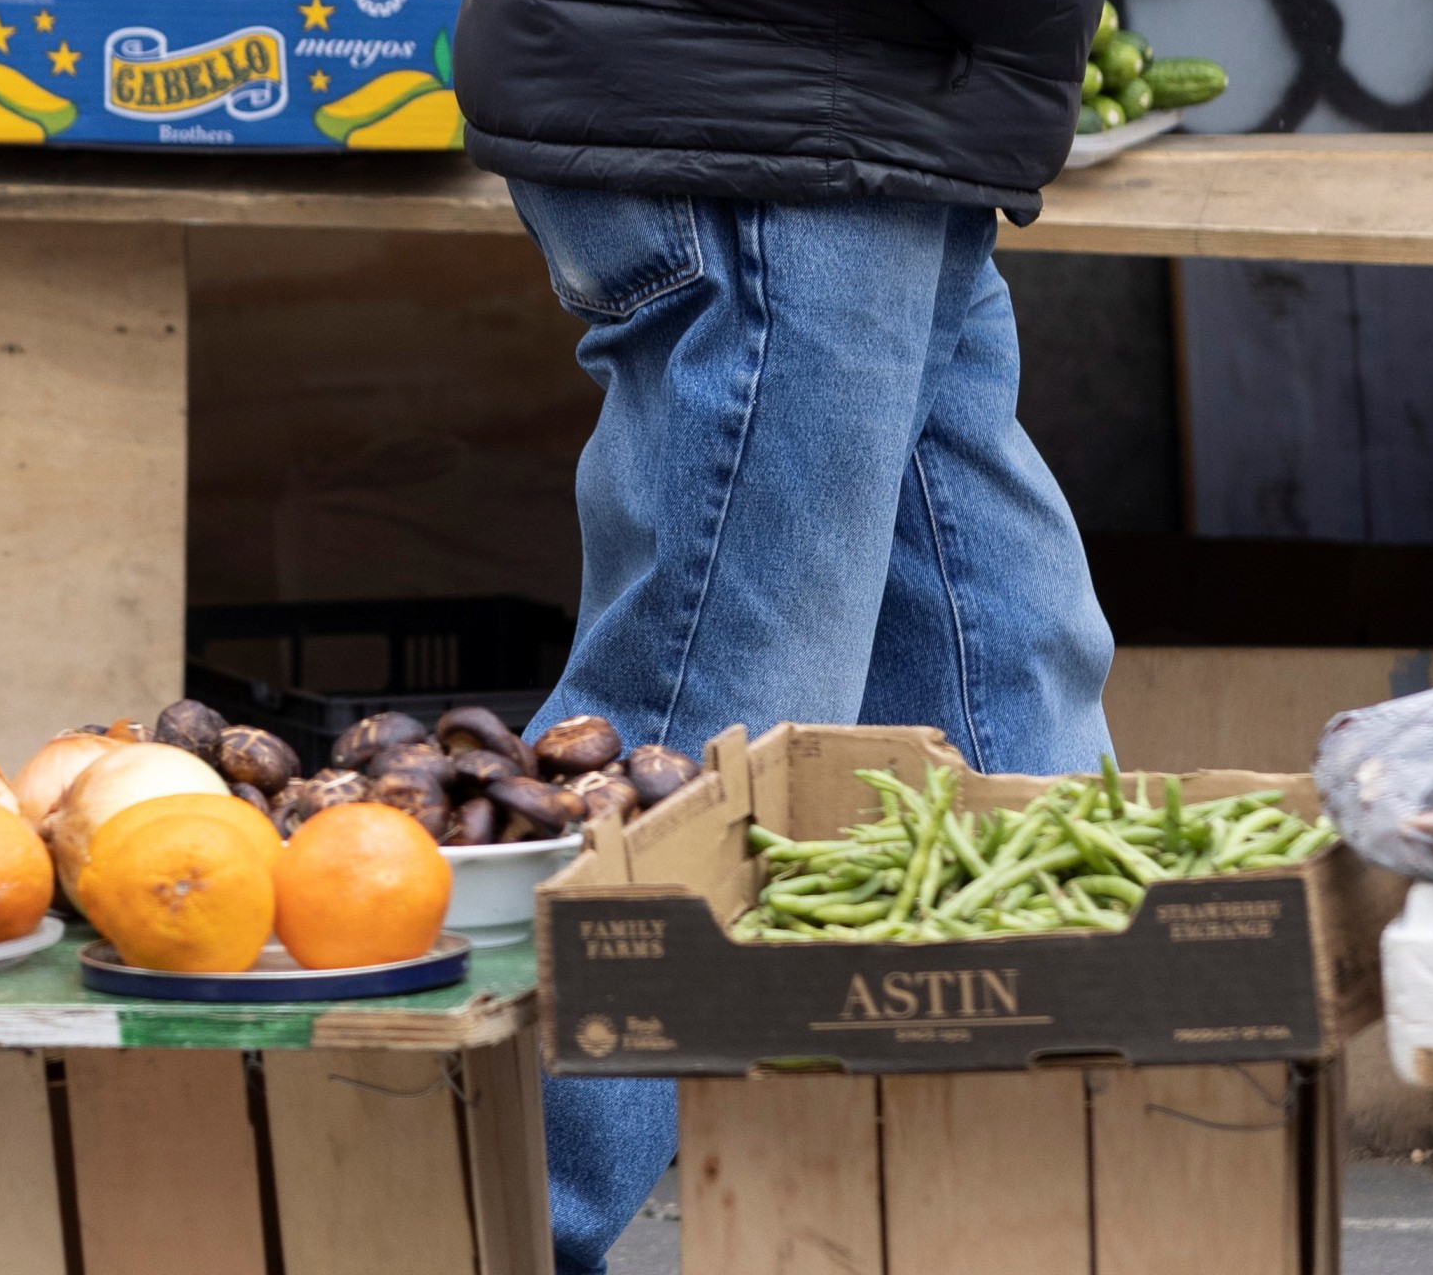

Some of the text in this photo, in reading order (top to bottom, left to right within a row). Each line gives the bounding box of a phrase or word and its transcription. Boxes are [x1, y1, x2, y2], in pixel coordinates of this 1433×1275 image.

[295, 36, 417, 69] mangos
[158, 123, 234, 144] Brothers
[579, 920, 668, 940] FAMILY
[586, 939, 666, 959] FARMS
[840, 968, 1021, 1020] ASTIN
